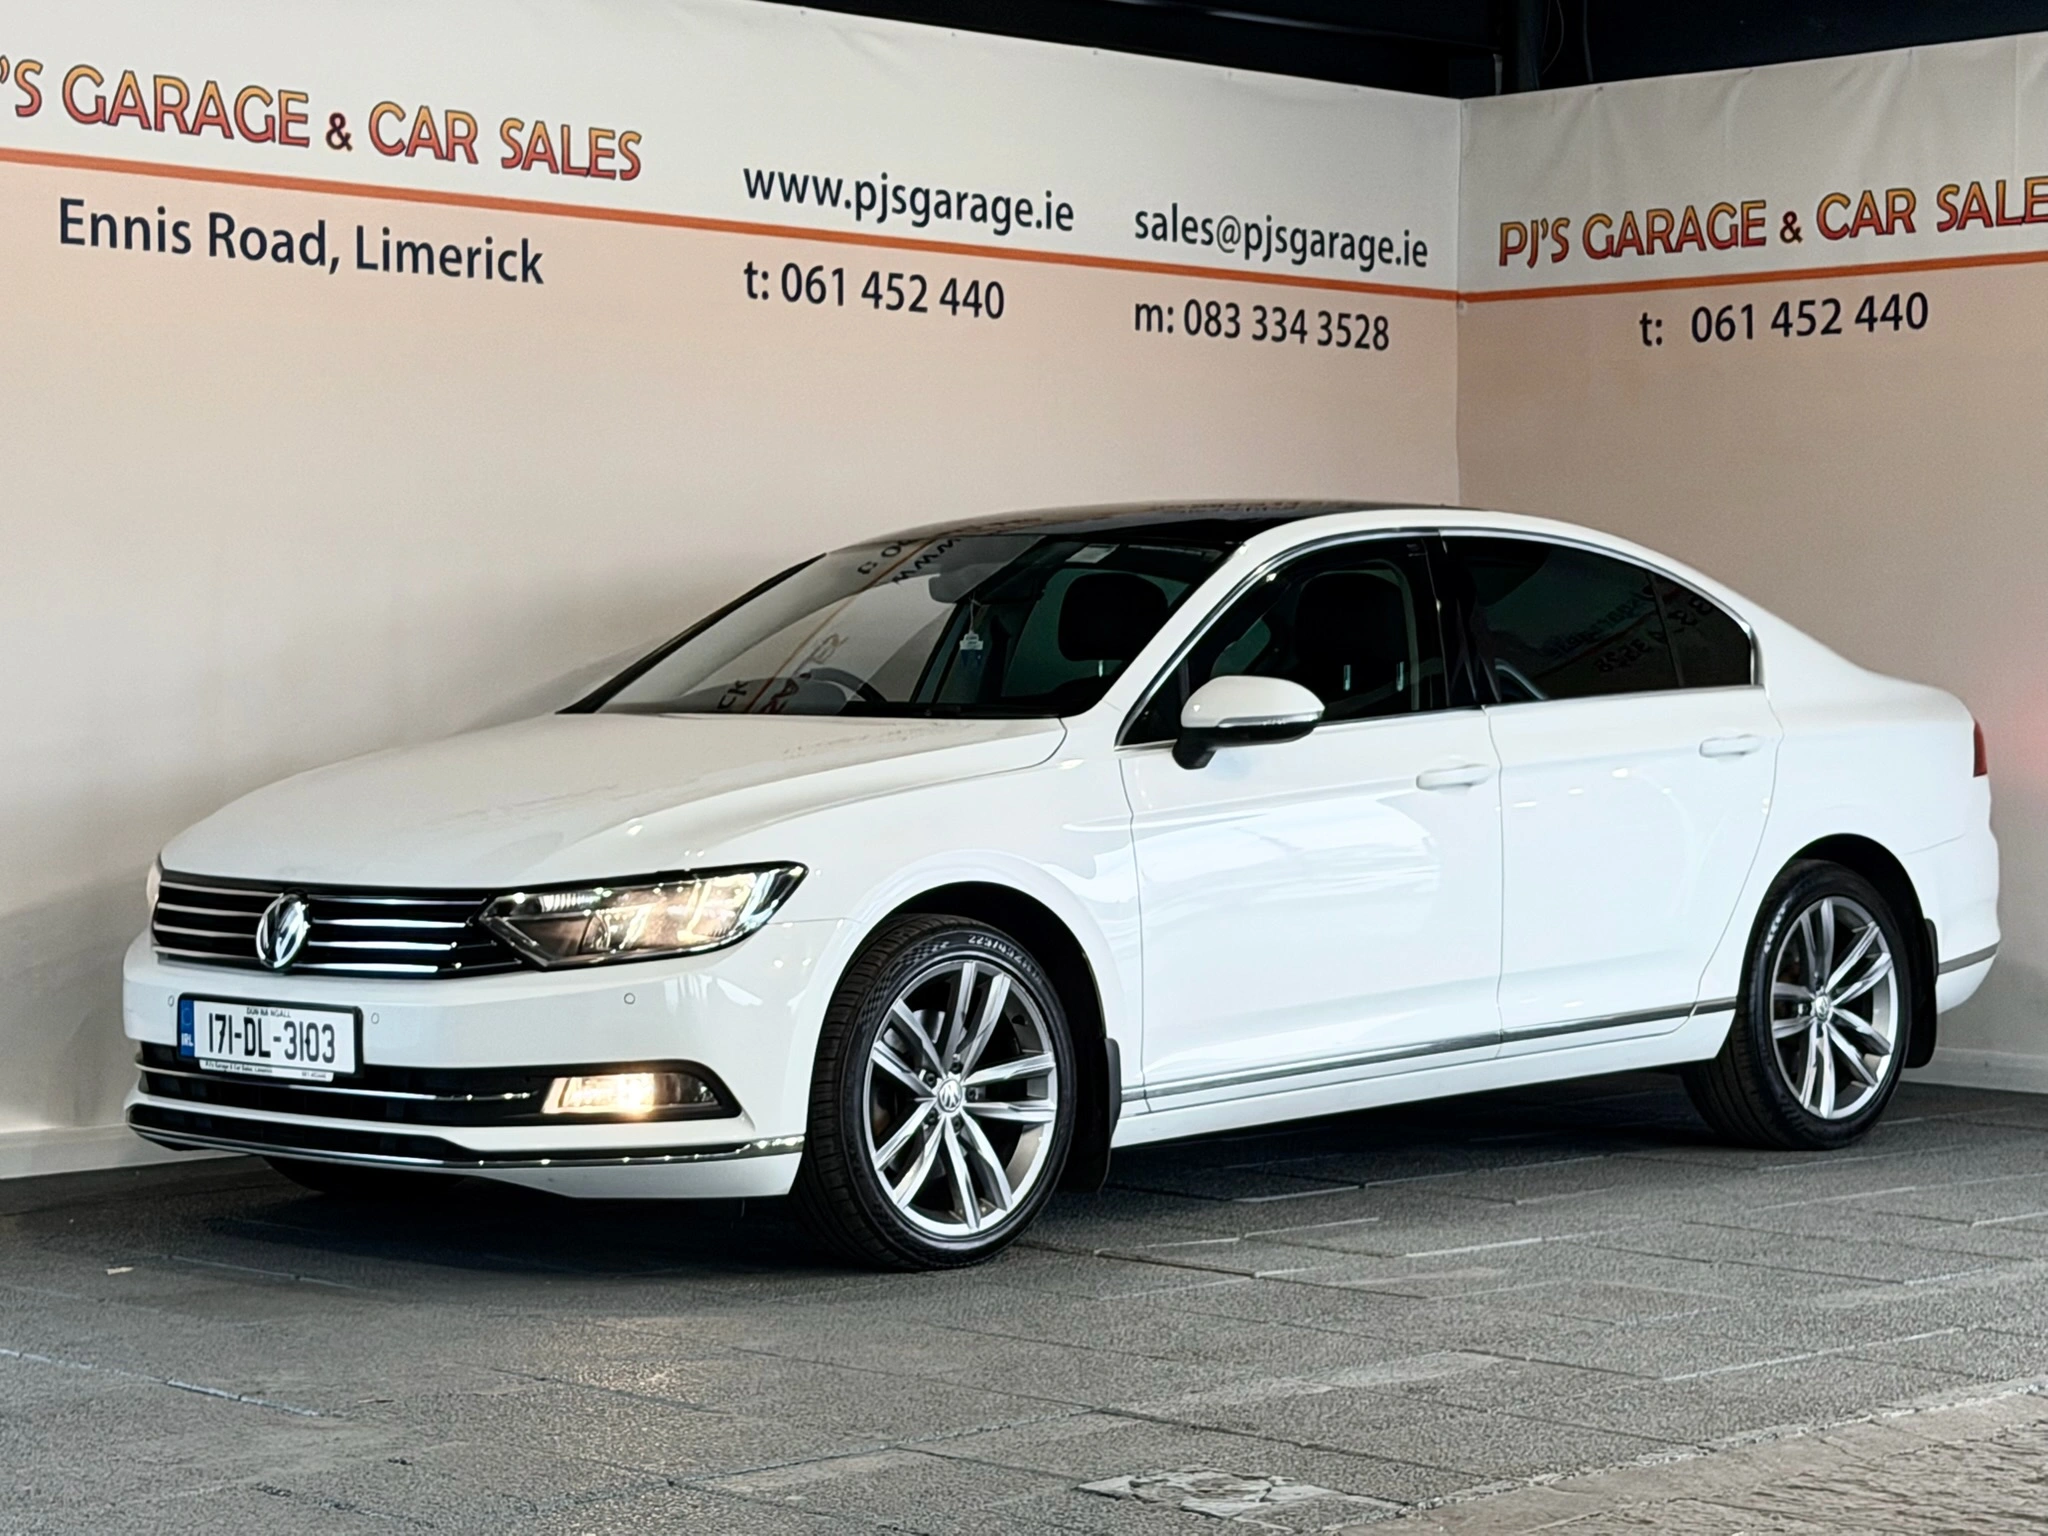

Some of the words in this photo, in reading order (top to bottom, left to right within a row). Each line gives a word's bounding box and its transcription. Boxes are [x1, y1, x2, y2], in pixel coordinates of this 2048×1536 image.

[62, 64, 310, 148] GARAGE
[325, 112, 353, 152] &
[368, 101, 479, 165] CAR
[500, 117, 642, 181] SALES
[743, 168, 1074, 236] www.pjsgarage.ie
[1499, 217, 1570, 269] PJ'S
[1582, 200, 1767, 260] GARAGE
[1780, 211, 1803, 244] &
[1816, 188, 1916, 241] CAR
[60, 197, 191, 254] Ennis
[209, 212, 339, 275] Road,
[357, 225, 544, 284] Limerick
[1134, 203, 1428, 272] sales@pjsgarage.ie
[743, 261, 769, 300] t:
[781, 262, 845, 306] 061
[861, 271, 928, 313] 452
[939, 278, 1004, 319] 440
[1639, 312, 1662, 346] t:
[1692, 304, 1753, 343] 061
[1771, 298, 1842, 338] 452
[1855, 292, 1928, 332] 440
[1135, 302, 1174, 334] m:
[1184, 299, 1240, 339] 083
[1252, 305, 1308, 345] 334
[1317, 310, 1389, 351] 3528
[208, 1012, 335, 1064] 171-DL-3103
